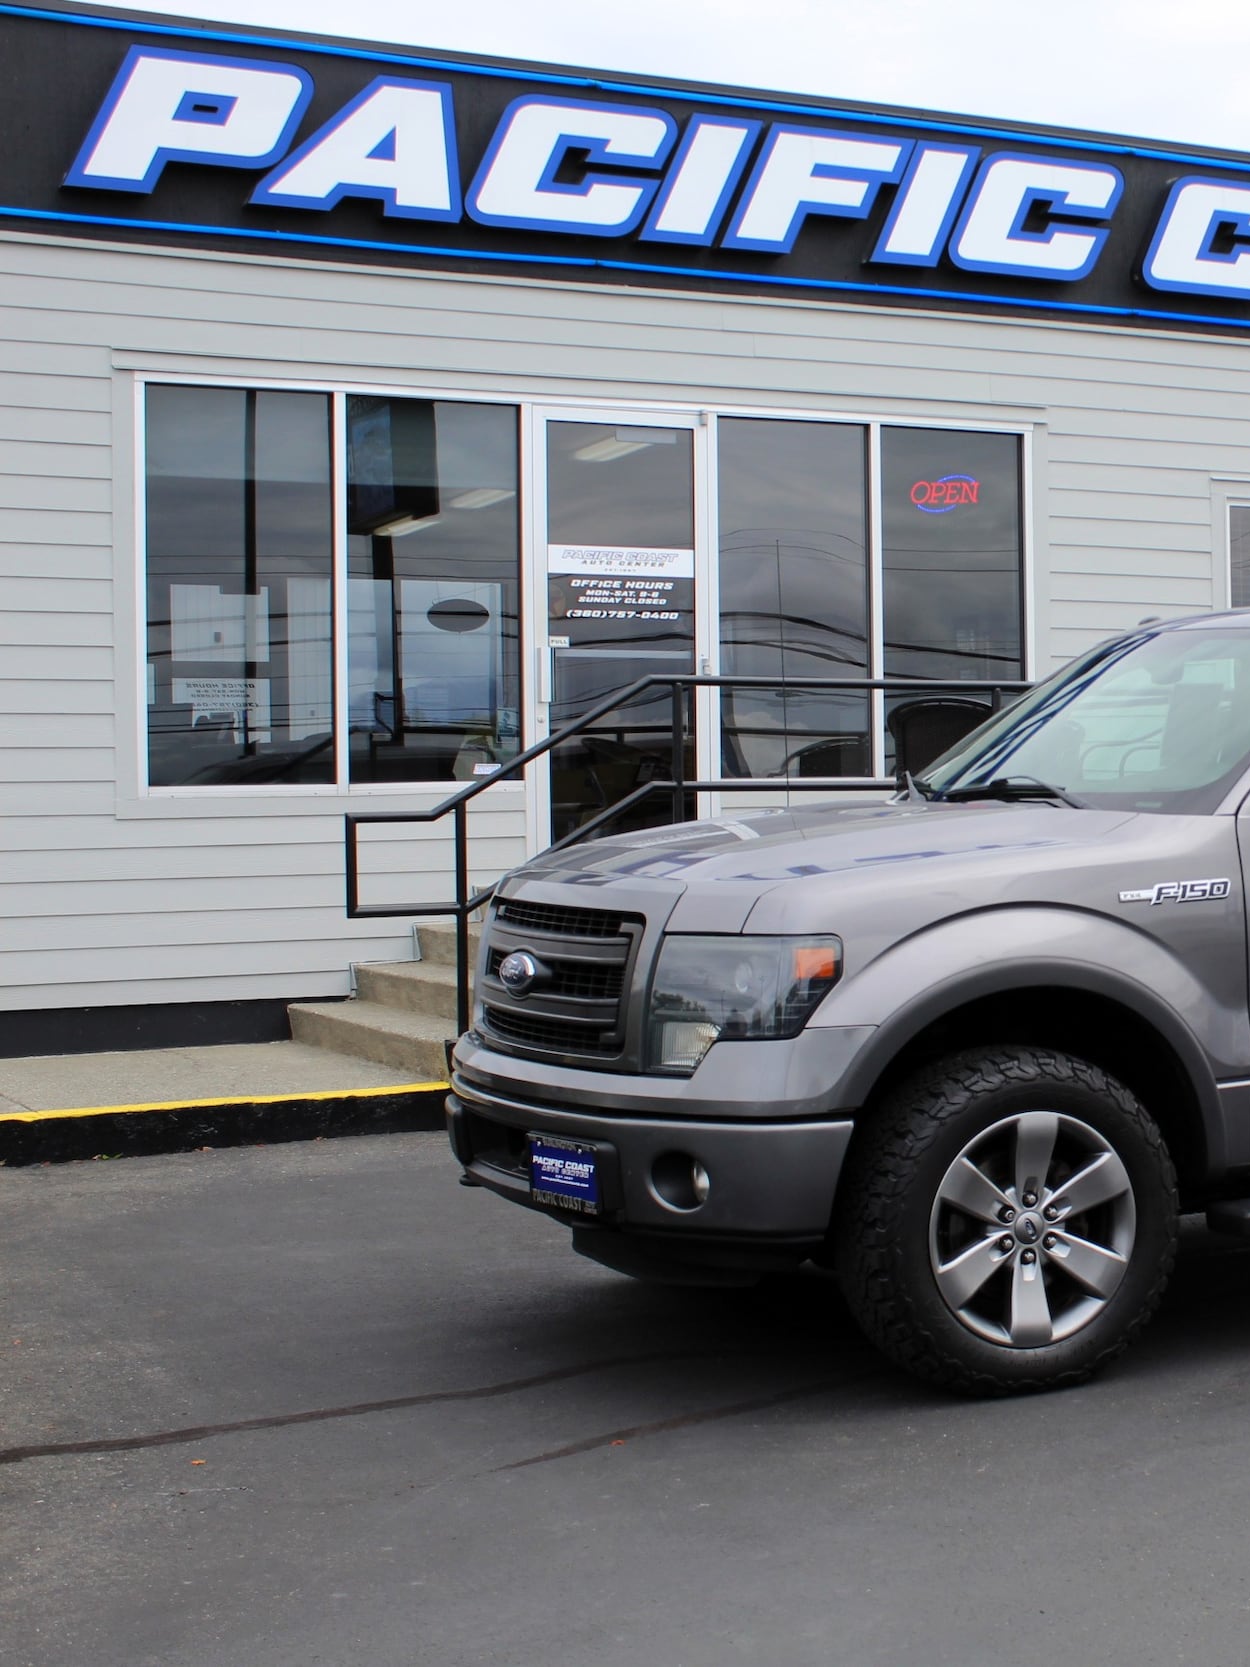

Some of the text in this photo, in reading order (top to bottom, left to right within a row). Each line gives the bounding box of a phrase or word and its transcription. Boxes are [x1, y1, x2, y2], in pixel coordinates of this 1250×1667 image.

[62, 44, 1125, 282] PACIFIC
[909, 481, 980, 504] OPEN
[562, 549, 679, 563] PACIFIC COAST
[571, 579, 674, 590] OFFICE HOURS
[578, 596, 667, 605] SUNDAY CLOSED
[1151, 879, 1230, 904] F-150
[532, 1155, 594, 1173] PACIFIC COAST
[533, 1189, 557, 1204] PACIFIC
[558, 1193, 582, 1211] COAST
